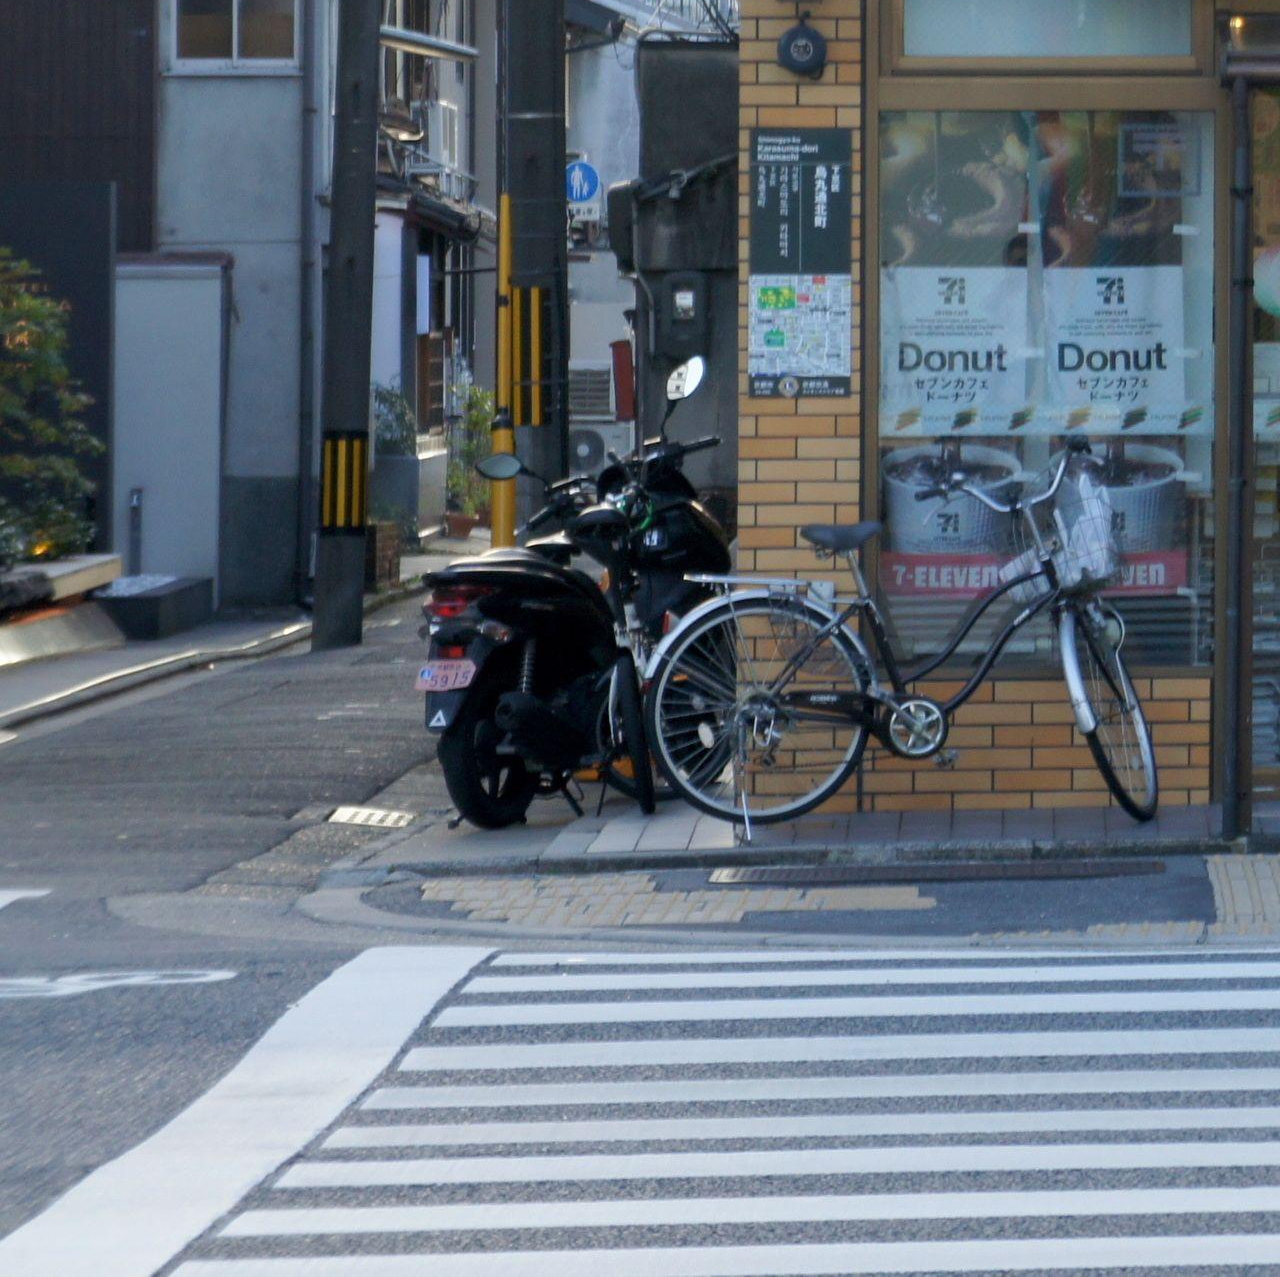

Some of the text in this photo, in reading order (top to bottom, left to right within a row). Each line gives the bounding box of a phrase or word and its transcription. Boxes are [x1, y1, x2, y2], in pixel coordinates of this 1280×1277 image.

[898, 341, 1008, 372] Donut
[1057, 341, 1167, 372] Donut
[914, 377, 989, 389] セブンカフェ
[1077, 377, 1150, 389] セブンカフェ
[926, 391, 977, 402] ドーナツ
[1090, 391, 1139, 402] ドーナツ
